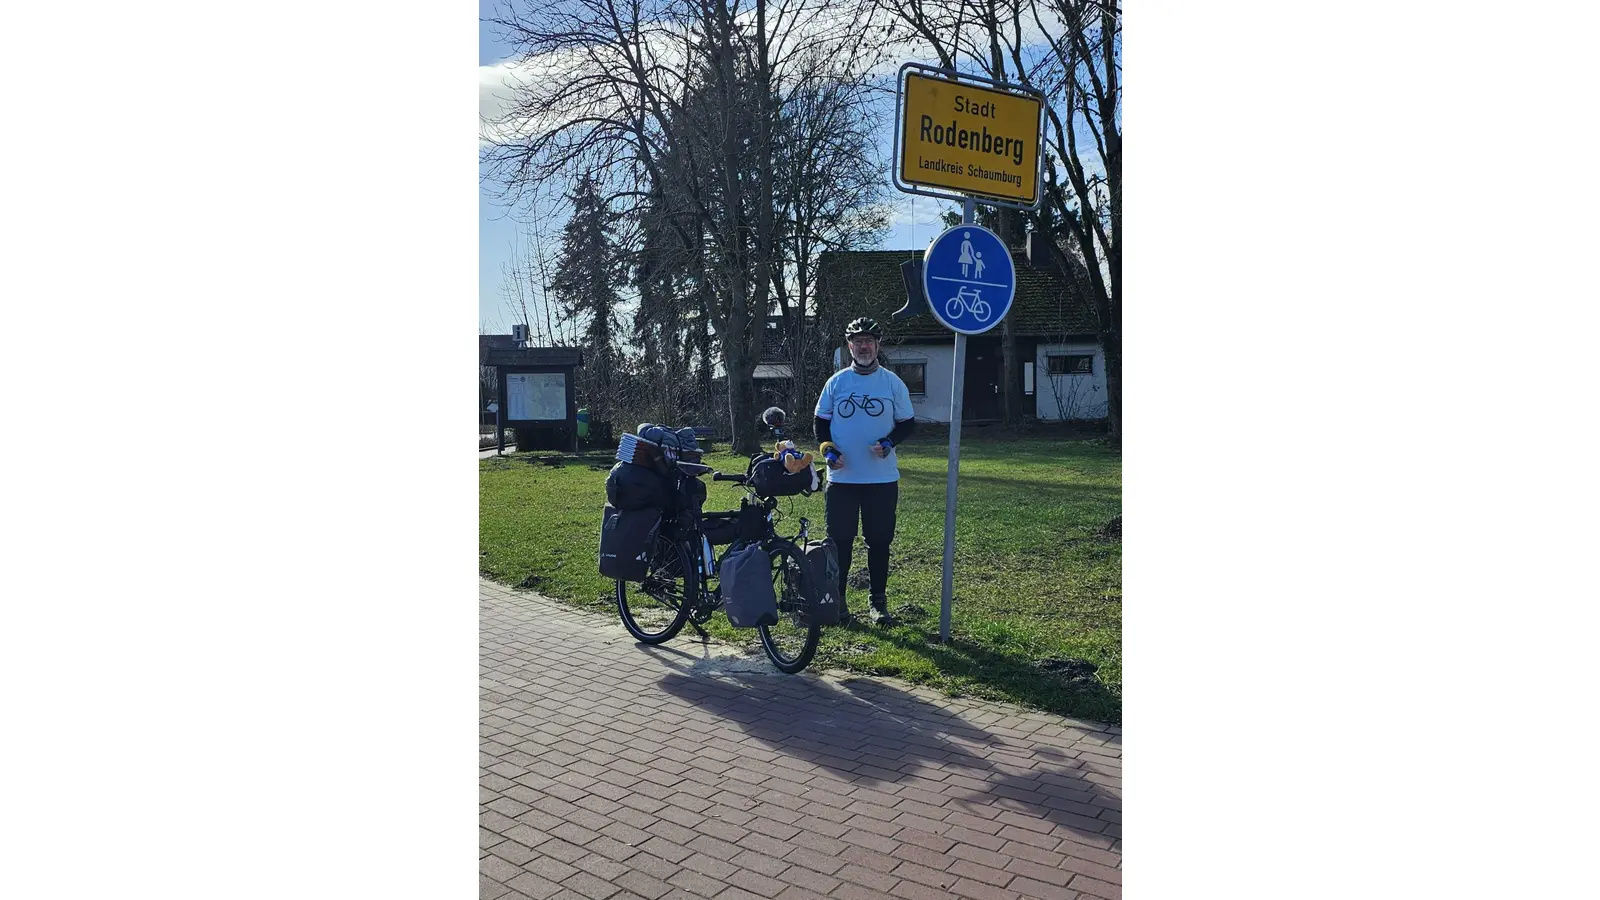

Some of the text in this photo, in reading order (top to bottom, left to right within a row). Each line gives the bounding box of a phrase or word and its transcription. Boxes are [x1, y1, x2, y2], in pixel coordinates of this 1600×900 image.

[954, 95, 996, 119] Stadt
[920, 114, 1024, 166] Rodenberg
[918, 155, 1022, 188] Landkreis Schaumburg
[516, 325, 521, 340] i
